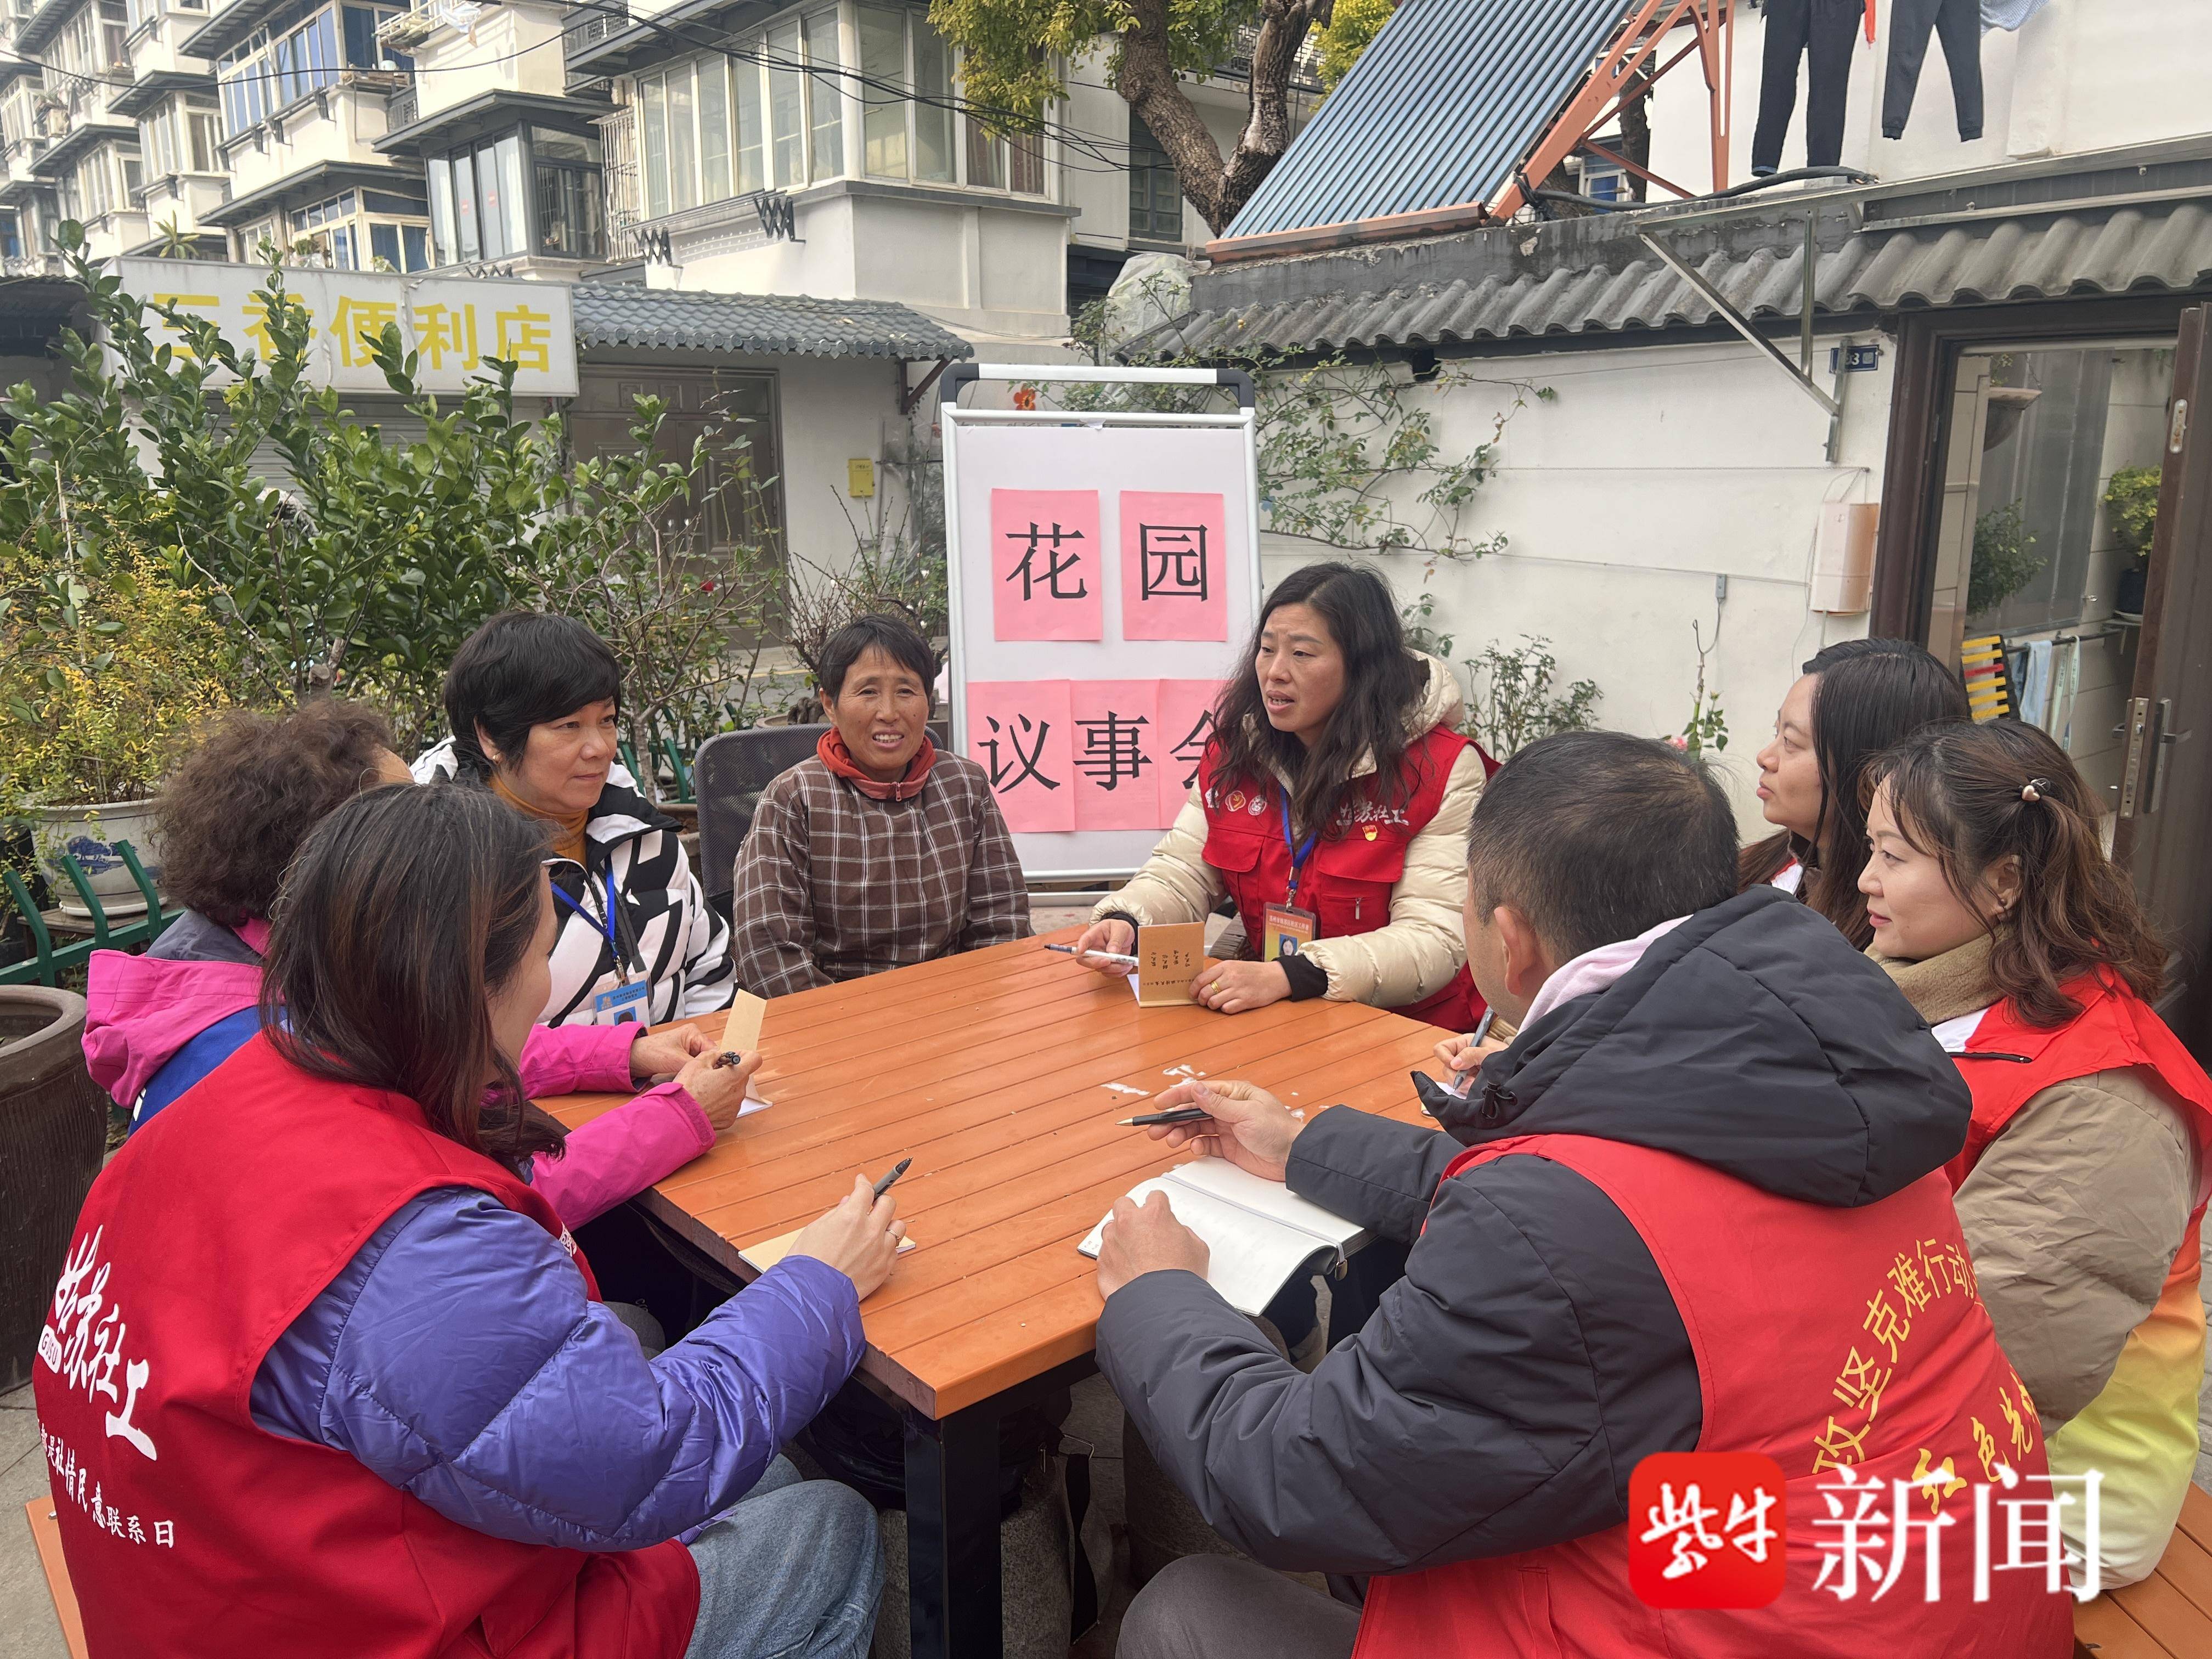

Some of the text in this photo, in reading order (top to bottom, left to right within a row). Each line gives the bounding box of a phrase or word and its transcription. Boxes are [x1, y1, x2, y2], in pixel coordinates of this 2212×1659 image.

[1005, 522, 1208, 602] 花园
[1812, 1238, 1978, 1475] 攻坚克难行动
[37, 1418, 174, 1548] 都是社情民意联系日
